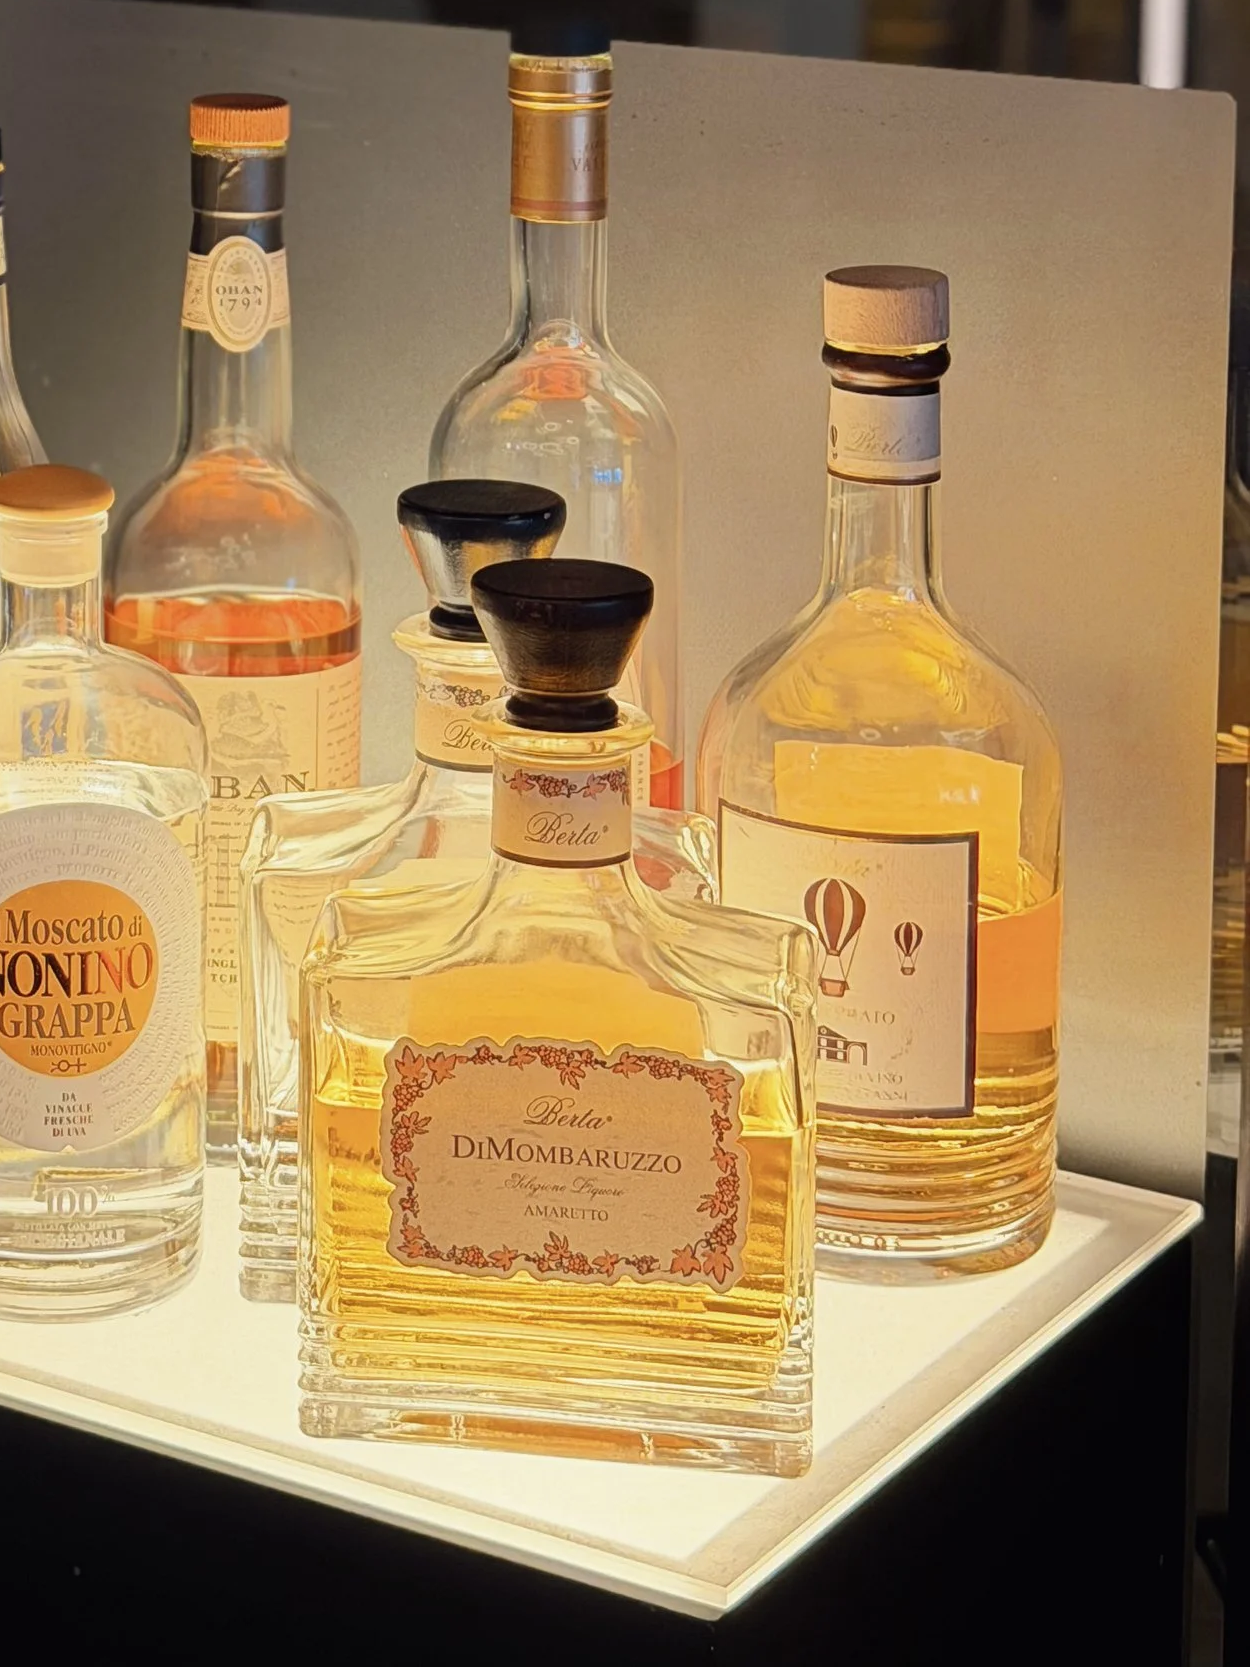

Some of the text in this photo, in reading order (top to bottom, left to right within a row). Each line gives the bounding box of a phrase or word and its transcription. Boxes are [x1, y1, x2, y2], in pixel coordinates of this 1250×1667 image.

[5, 908, 124, 946] Moscato
[128, 915, 143, 938] di
[207, 959, 238, 969] INGL
[210, 973, 238, 984] TCH
[30, 1041, 107, 1056] MONOVITIGNO
[62, 1092, 77, 1102] DA
[43, 1115, 94, 1126] FRESCHE
[52, 1127, 64, 1138] DI
[524, 1203, 609, 1222] AMARETTO
